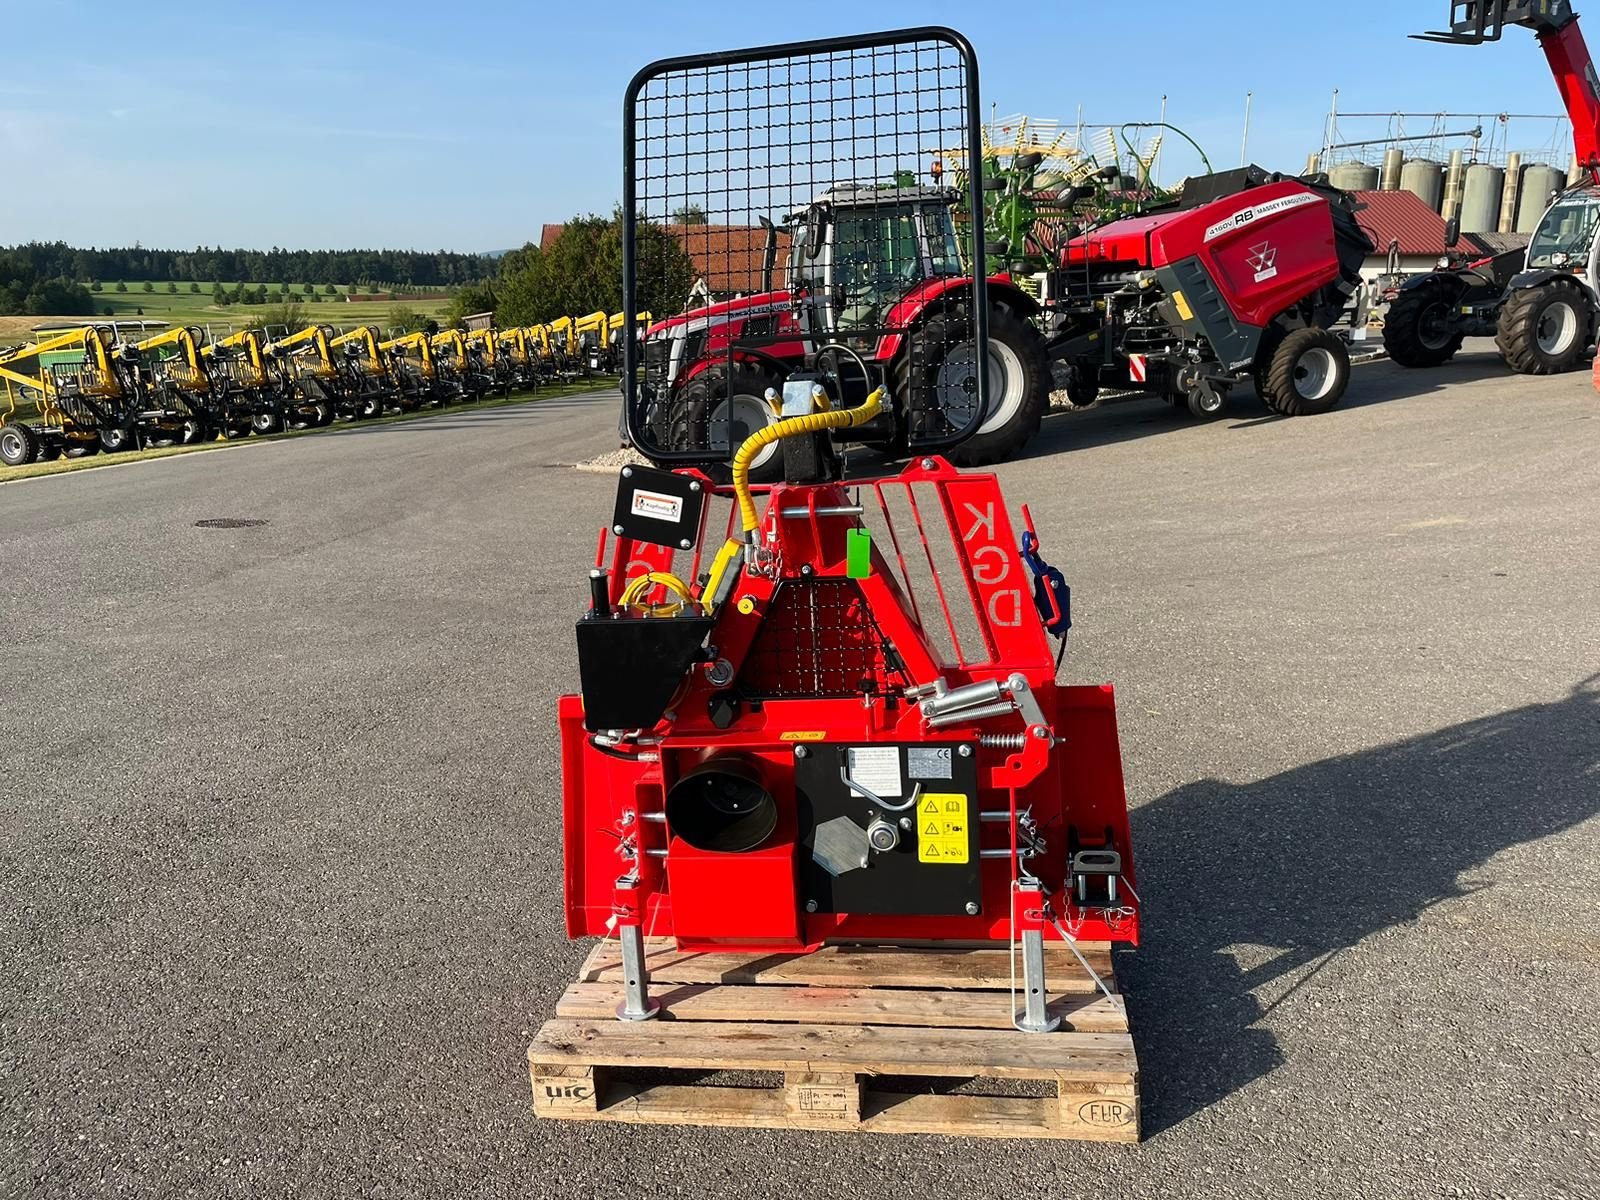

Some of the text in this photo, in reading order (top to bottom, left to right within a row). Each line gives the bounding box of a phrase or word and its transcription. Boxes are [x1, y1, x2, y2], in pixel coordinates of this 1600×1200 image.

[1234, 210, 1254, 225] RB
[1257, 203, 1280, 214] MASSEY
[1280, 195, 1311, 207] FERGUSON
[937, 749, 950, 759] CE
